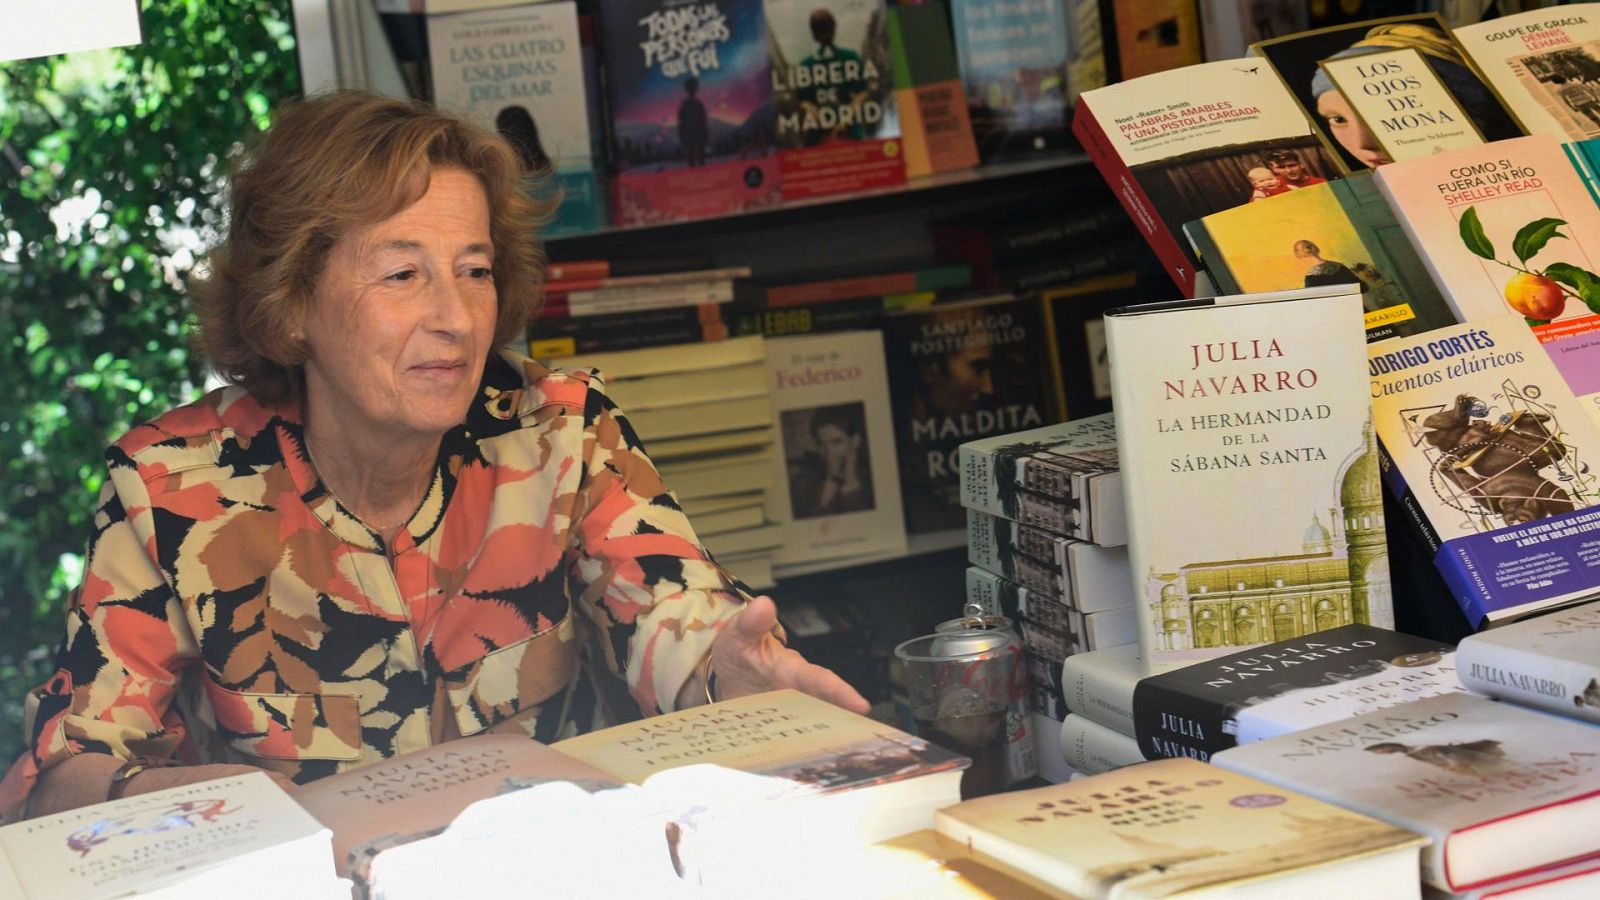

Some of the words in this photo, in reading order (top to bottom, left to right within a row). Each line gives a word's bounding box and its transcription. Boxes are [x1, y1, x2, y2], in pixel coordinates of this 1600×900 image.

[638, 5, 696, 37] TODAS
[1486, 27, 1525, 43] GOLPE
[1526, 23, 1542, 33] DE
[1543, 16, 1588, 30] GRACIA
[1521, 28, 1565, 43] DENNIS
[449, 43, 483, 63] LAS
[488, 37, 565, 60] CUATRO
[640, 15, 730, 68] PERSONAS
[1526, 35, 1574, 51] LEHANE
[462, 59, 557, 83] ESQUINAS
[772, 59, 879, 90] LIBRERA
[1356, 60, 1403, 79] LOS
[470, 83, 506, 102] DEL
[510, 80, 552, 97] MAR
[816, 87, 838, 104] DE
[1363, 76, 1422, 97] OJOS
[1115, 112, 1134, 125] Noel
[1167, 101, 1191, 111] Smith
[1119, 111, 1178, 133] PALABRAS
[1181, 100, 1232, 118] AMABLES
[1387, 94, 1423, 112] DE
[777, 102, 882, 134] MADRID
[1124, 132, 1132, 142] Y
[1134, 126, 1160, 140] UNA
[1162, 115, 1206, 132] PISTOLA
[1208, 105, 1261, 121] CARGADA
[1380, 110, 1454, 133] MONA
[1395, 134, 1427, 146] Thomas
[1437, 176, 1486, 195] FUERA
[1487, 171, 1510, 185] UN
[1512, 165, 1536, 180] RÍO
[1450, 162, 1497, 178] COMO
[1499, 158, 1513, 169] SI
[1443, 186, 1504, 206] SHELLEY
[1506, 177, 1543, 193] READ
[921, 313, 1013, 337] SANTIAGO
[1365, 309, 1408, 324] AMARILLO
[910, 325, 1026, 355] POSTEGUILLO
[1428, 329, 1495, 361] CORTÉS
[1542, 335, 1552, 343] del
[1190, 338, 1285, 370] JULIA
[775, 362, 862, 390] Federico
[1164, 367, 1319, 401] NAVARRO
[1371, 370, 1443, 398] Cuentos
[1447, 350, 1525, 381] telúricos
[911, 404, 1042, 443] MALDITA
[1157, 418, 1183, 433] LA
[1191, 404, 1331, 430] HERMANDAD
[1223, 435, 1243, 446] DE
[1251, 433, 1270, 444] LA
[1170, 451, 1251, 474] SÁBANA
[1260, 447, 1327, 466] SANTA
[1492, 532, 1520, 544] VUELVE
[1528, 524, 1552, 535] AUTOR
[1550, 520, 1567, 530] QUE
[1566, 518, 1577, 526] HA
[1522, 536, 1540, 546] MÁS
[1539, 533, 1550, 542] DE
[1549, 527, 1579, 540] 100.000
[1458, 548, 1475, 573] HOUSE
[1471, 570, 1491, 600] RANDOM
[1204, 639, 1378, 689] NAVARRO
[1217, 641, 1327, 673] JULIA
[1304, 666, 1456, 706] HISTORIA
[1359, 691, 1398, 704] DE
[1409, 680, 1441, 694] UN
[1469, 663, 1506, 686] JULIA
[1508, 671, 1567, 700] NAVARRO
[620, 707, 778, 747] NAVARRO
[636, 740, 669, 753] LA
[681, 712, 799, 740] SANGRE
[639, 708, 737, 733] JULIA
[1161, 712, 1205, 740] JULIA
[1298, 714, 1408, 747] JULIA
[645, 721, 831, 766] INOCENTES
[690, 739, 713, 748] DE
[1152, 736, 1210, 764] NAVARR
[1281, 712, 1460, 761] NAVARRO
[342, 748, 504, 798] NAVARRO
[364, 750, 459, 782] JULIA
[410, 758, 510, 789] BIBLIA
[424, 764, 512, 793] BARRO
[27, 810, 104, 834] JULIA
[114, 780, 244, 809] NAVARRO
[1017, 779, 1225, 823] NAVARRO
[1036, 780, 1168, 811] JULIA
